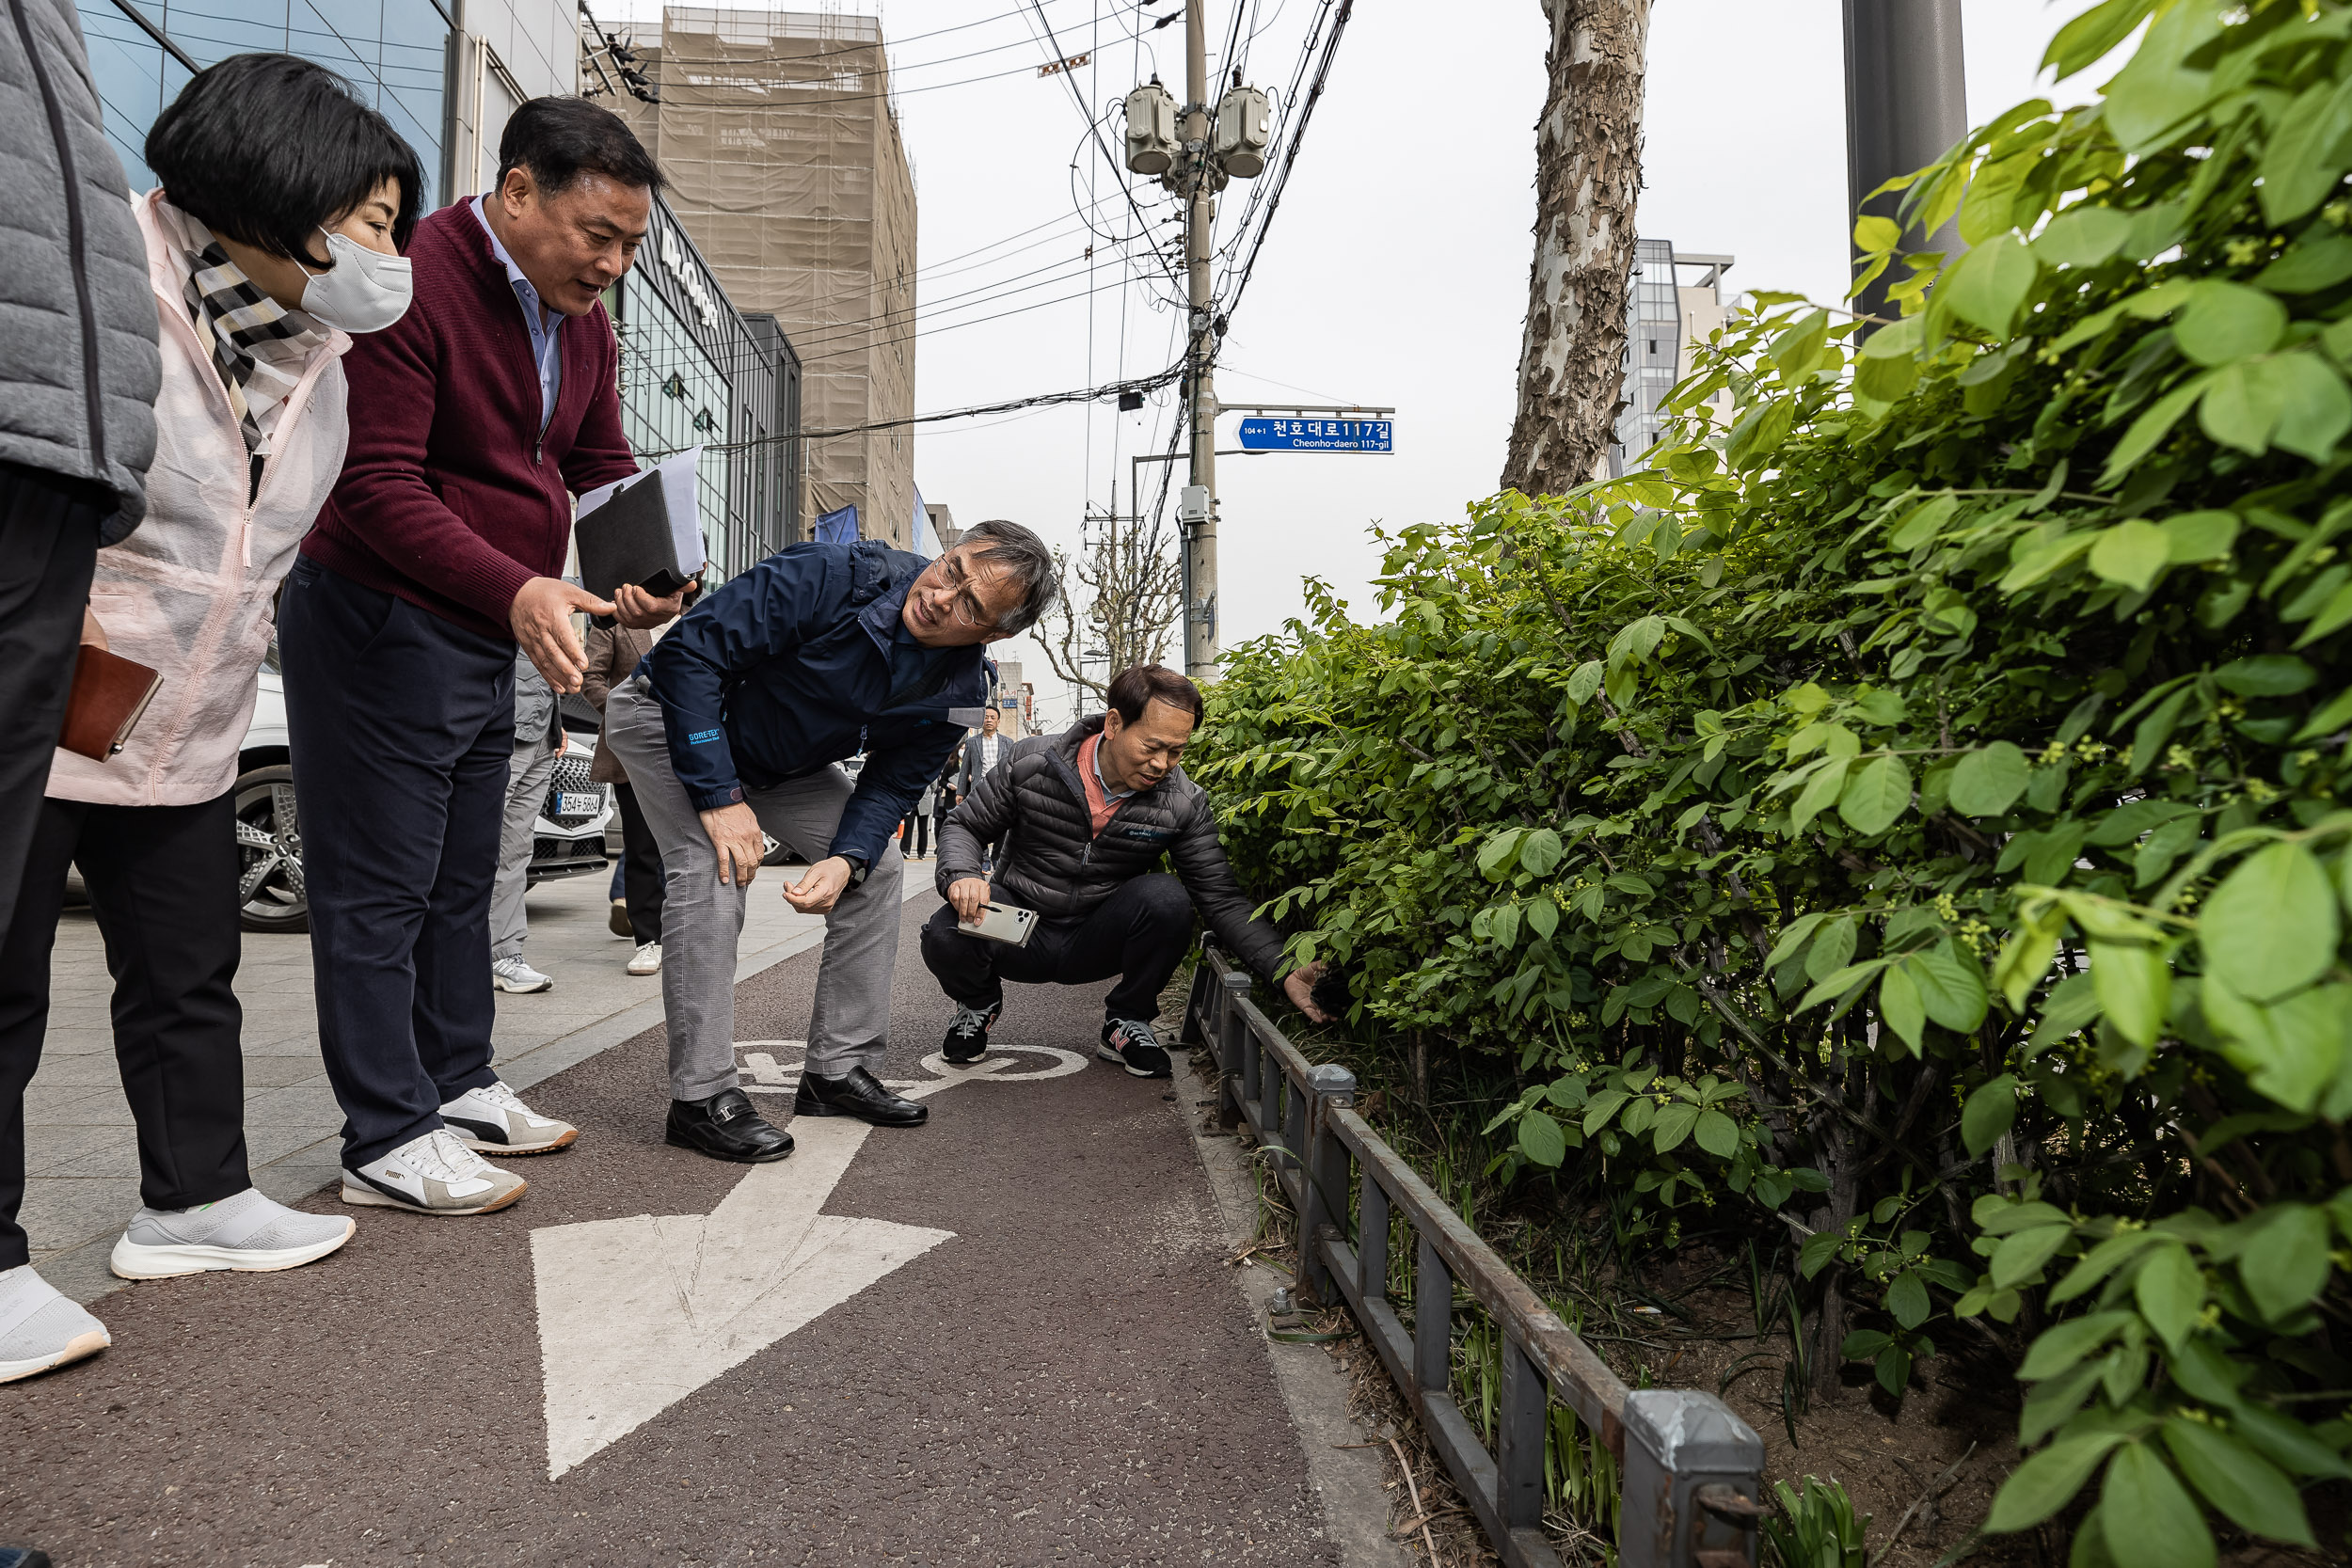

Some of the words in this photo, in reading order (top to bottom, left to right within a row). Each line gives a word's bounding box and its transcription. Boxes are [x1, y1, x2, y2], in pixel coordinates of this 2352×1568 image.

[1273, 420, 1390, 439] 천호대로117길
[1293, 438, 1359, 449] Cheonho-daero
[1360, 439, 1390, 450] 117-gil
